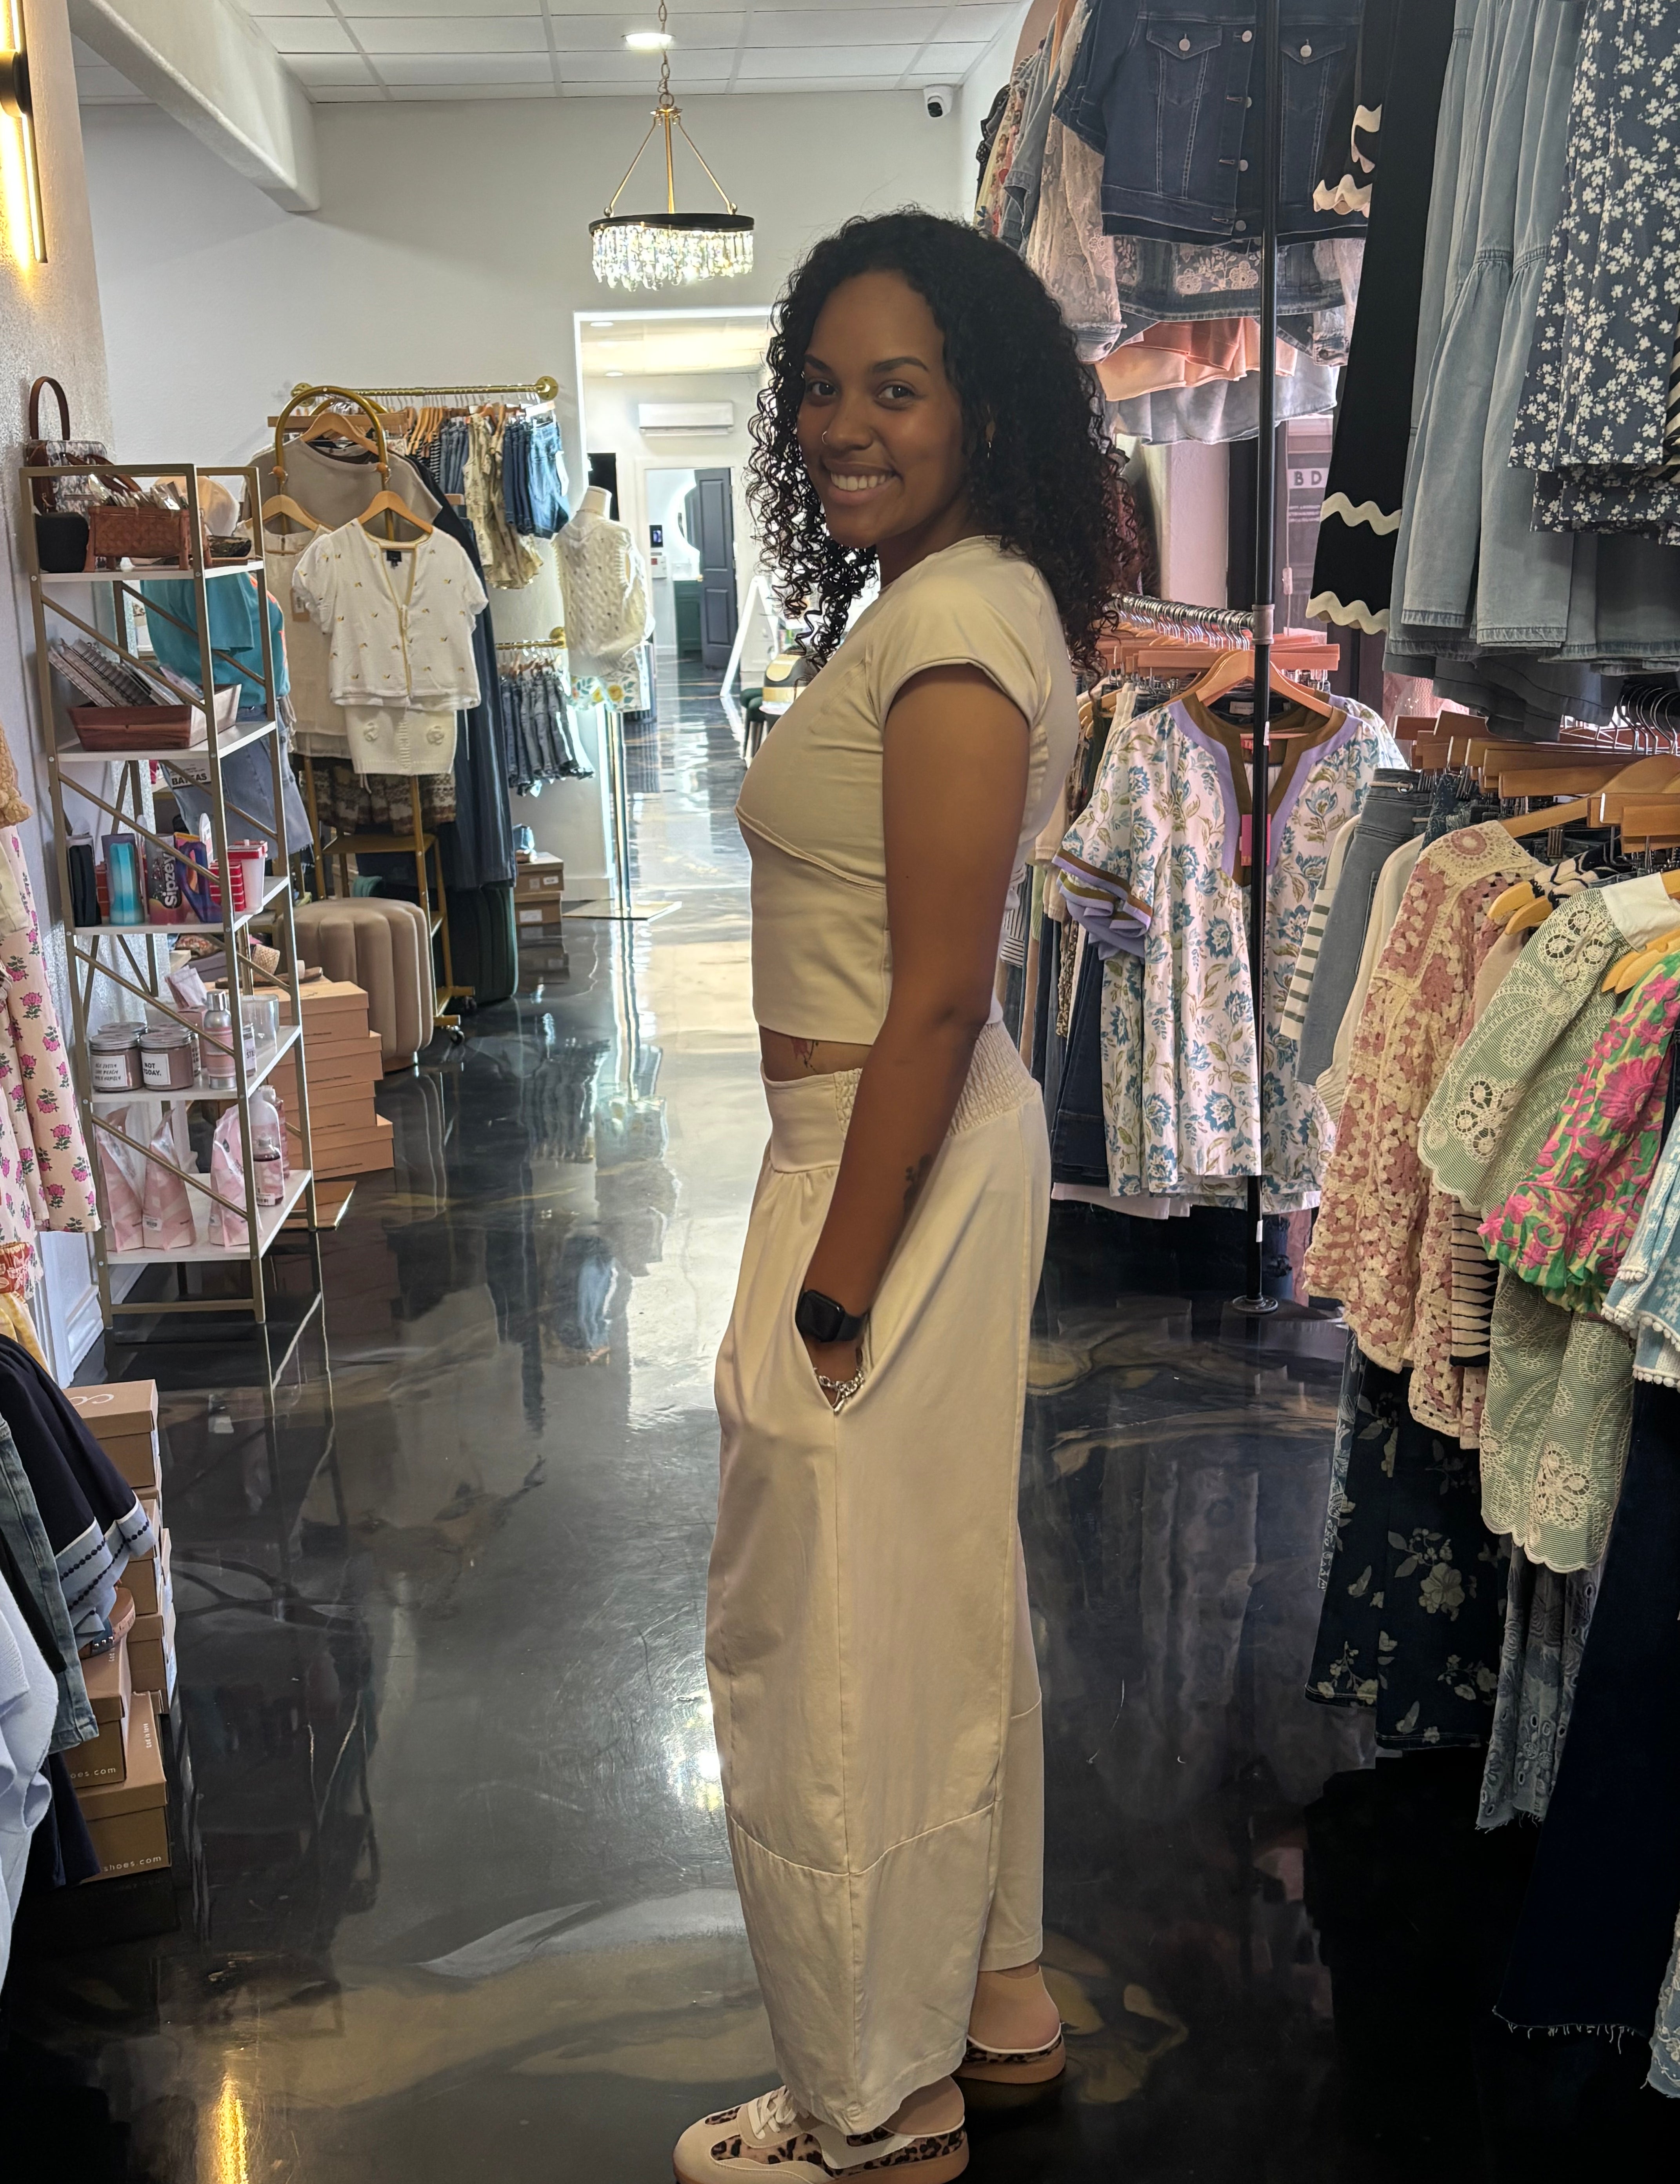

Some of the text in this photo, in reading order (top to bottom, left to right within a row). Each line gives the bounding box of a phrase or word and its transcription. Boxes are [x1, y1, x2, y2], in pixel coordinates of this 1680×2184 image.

[172, 773, 207, 785] BAAS
[162, 853, 179, 906] Sipzey
[103, 1856, 161, 1872] shoes.com
